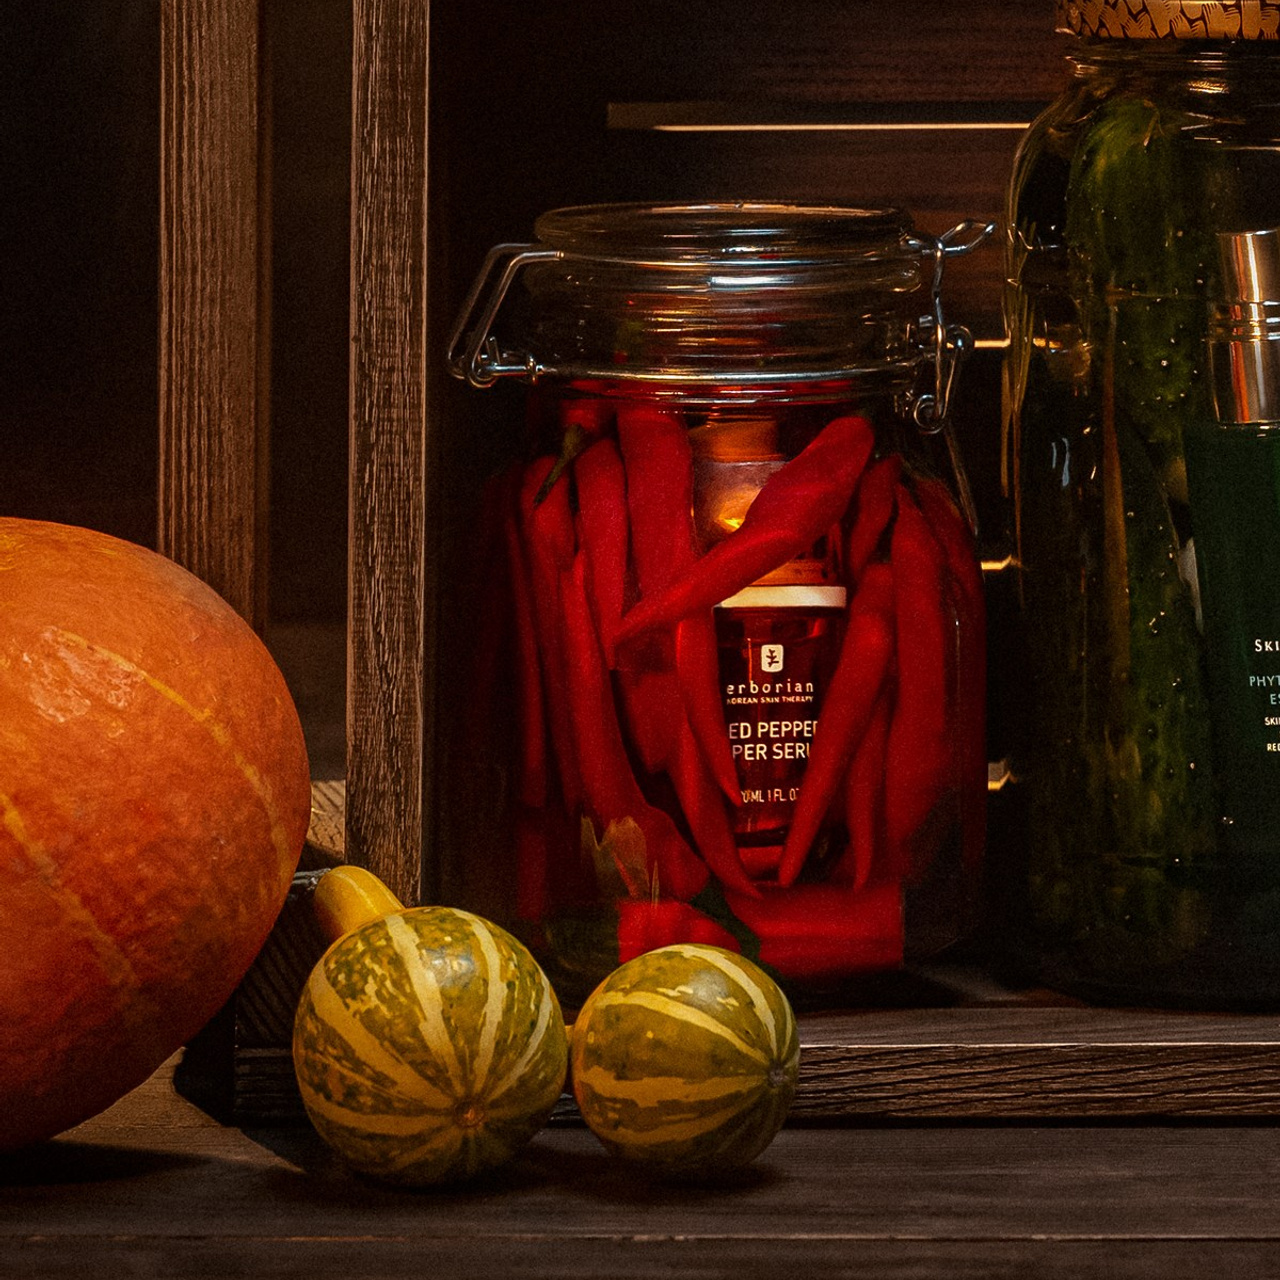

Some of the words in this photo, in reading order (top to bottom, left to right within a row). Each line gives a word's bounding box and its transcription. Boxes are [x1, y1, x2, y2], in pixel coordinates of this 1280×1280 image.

[726, 678, 814, 695] erborian
[729, 722, 752, 740] ED
[732, 744, 767, 760] PER
[772, 742, 810, 759] SER
